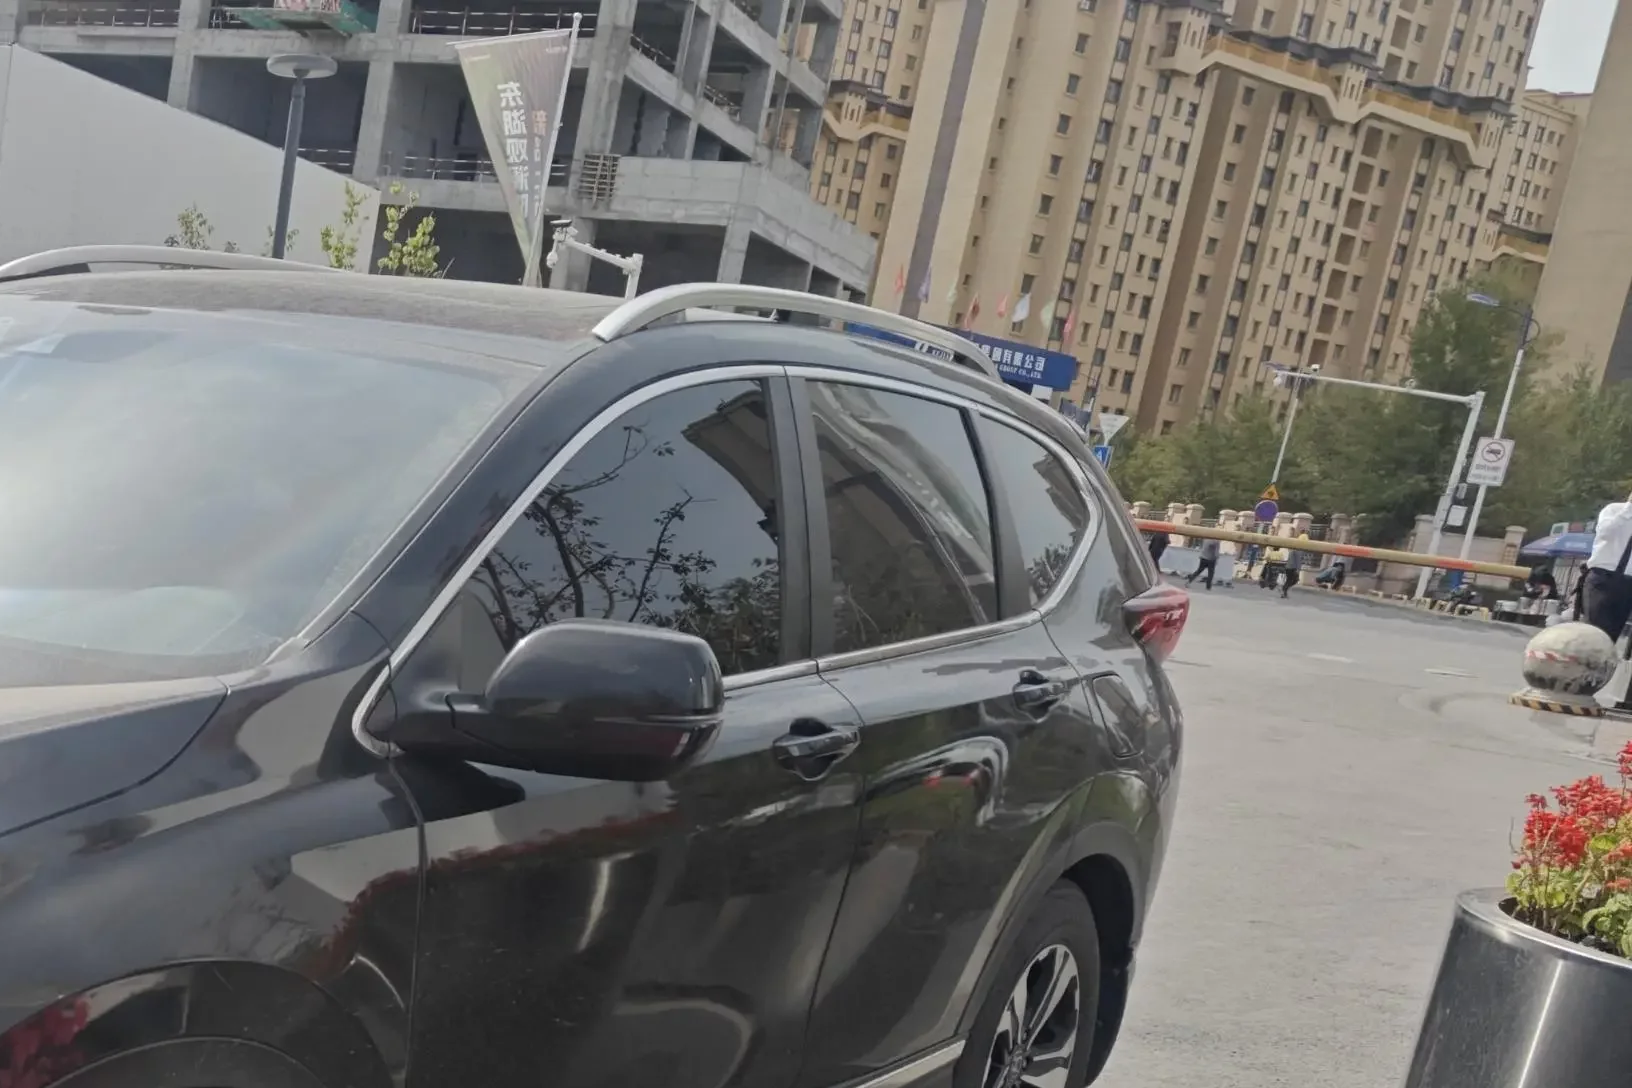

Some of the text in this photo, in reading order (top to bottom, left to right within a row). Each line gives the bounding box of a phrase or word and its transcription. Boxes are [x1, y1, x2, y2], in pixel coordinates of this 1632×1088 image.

[976, 343, 1047, 372] 集团有限公司
